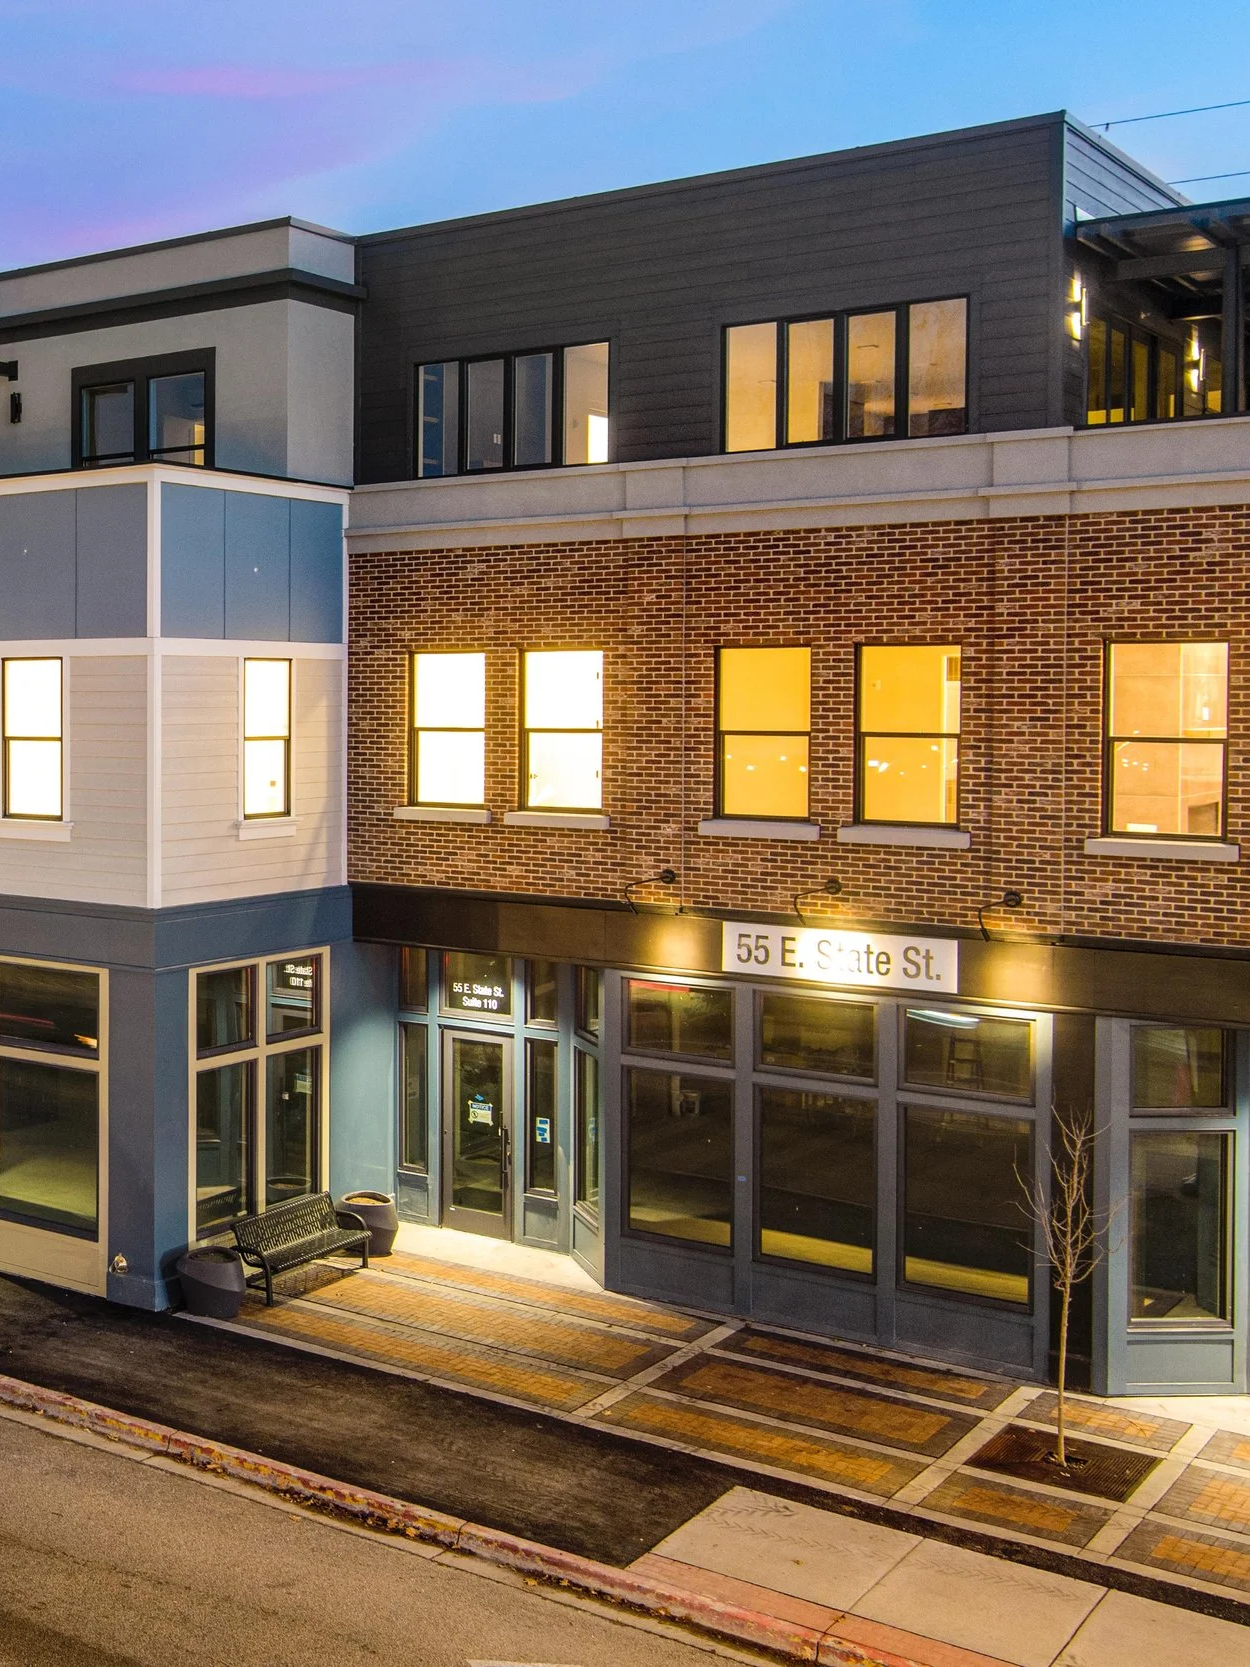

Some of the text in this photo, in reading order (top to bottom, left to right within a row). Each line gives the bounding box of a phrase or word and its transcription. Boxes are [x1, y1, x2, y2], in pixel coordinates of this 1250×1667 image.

[736, 933, 770, 964] 55
[781, 936, 804, 968] E.
[902, 945, 941, 981] St.
[453, 982, 463, 993] 55
[472, 984, 493, 996] State
[493, 986, 505, 998] St.
[462, 995, 498, 1010] Suite 110
